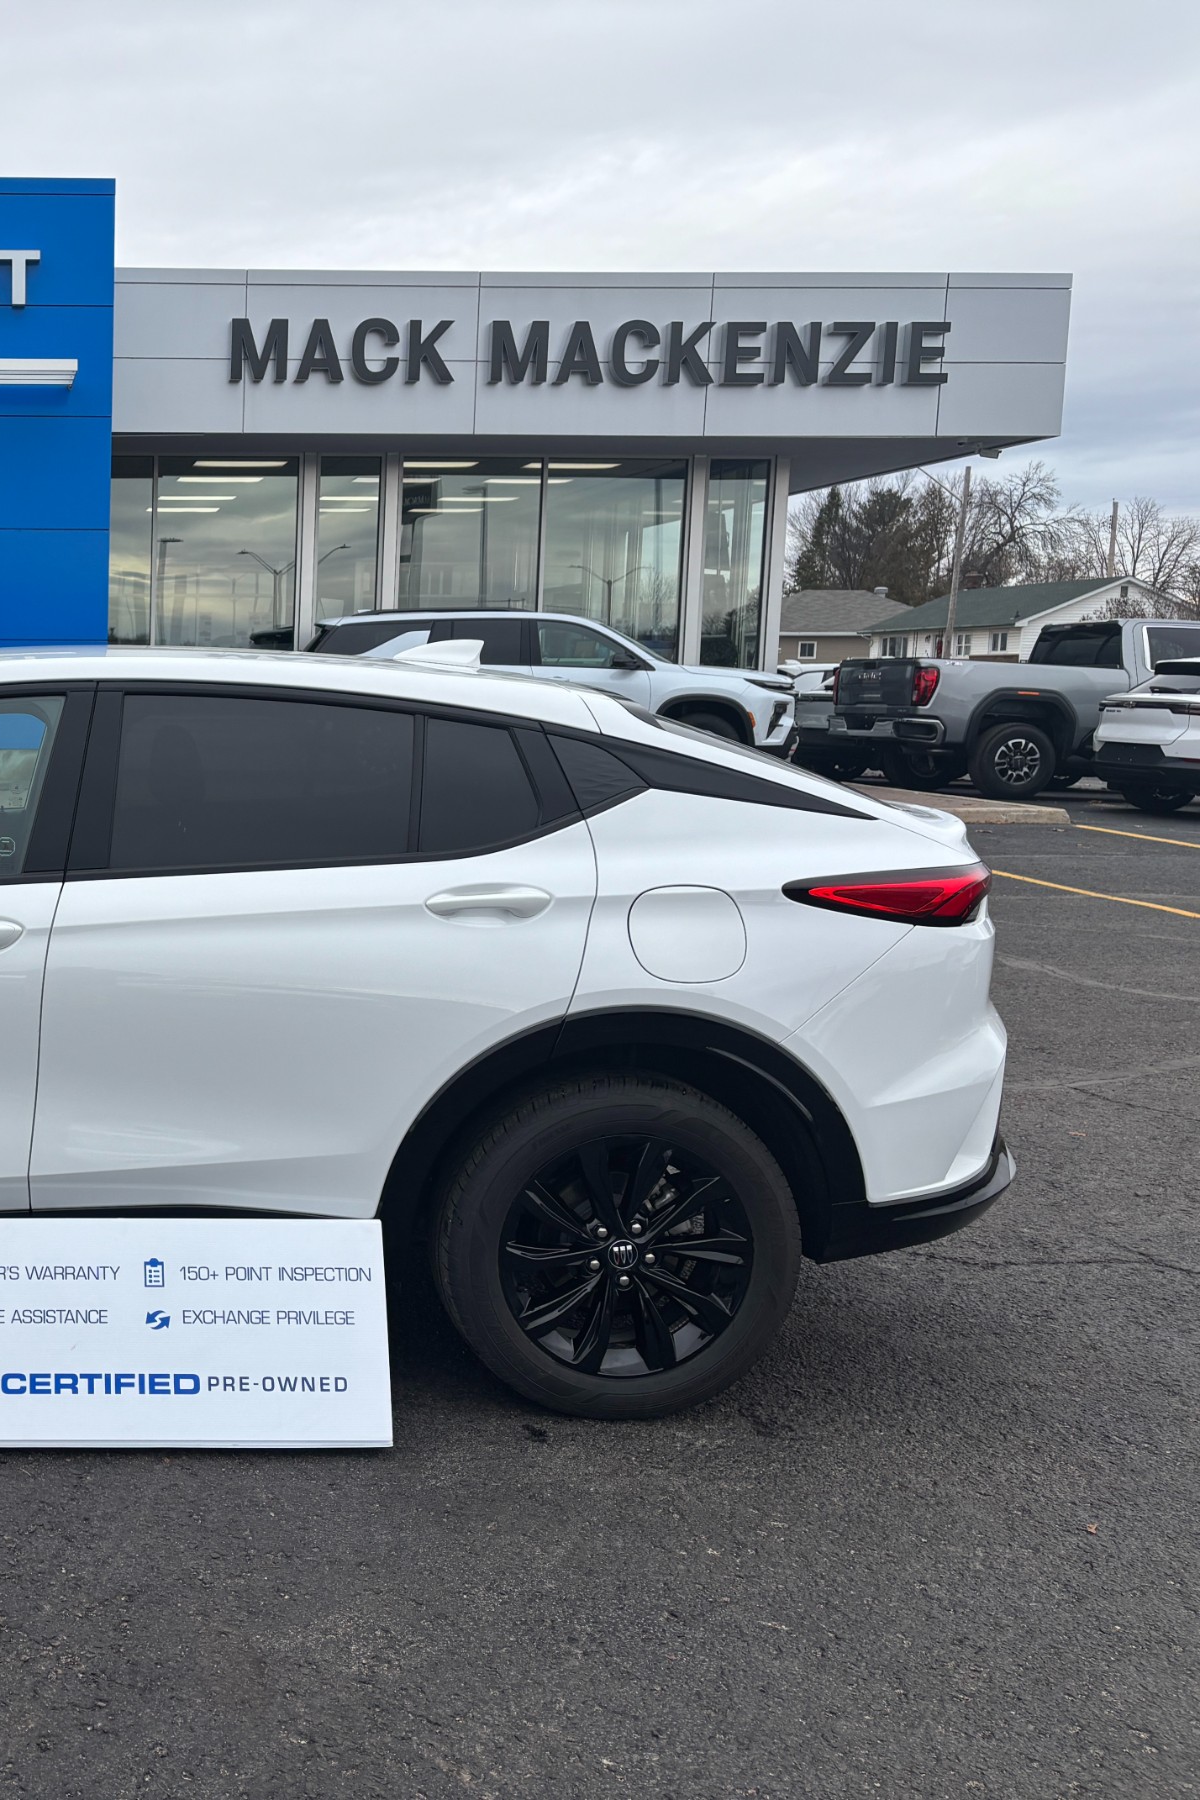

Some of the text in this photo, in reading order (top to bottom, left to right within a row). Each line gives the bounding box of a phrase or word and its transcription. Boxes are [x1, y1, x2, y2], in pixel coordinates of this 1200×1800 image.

[229, 317, 951, 386] MACK MACKENZIE
[25, 1266, 121, 1281] WARRANTY
[179, 1266, 372, 1282] 150+ POINT INSPECTION
[11, 1309, 108, 1325] ASSISTANCE
[182, 1310, 356, 1325] EXCHANGE PRIVILEGE
[1, 1373, 201, 1395] CERTIFIED
[207, 1376, 348, 1392] PRE-OWNED
